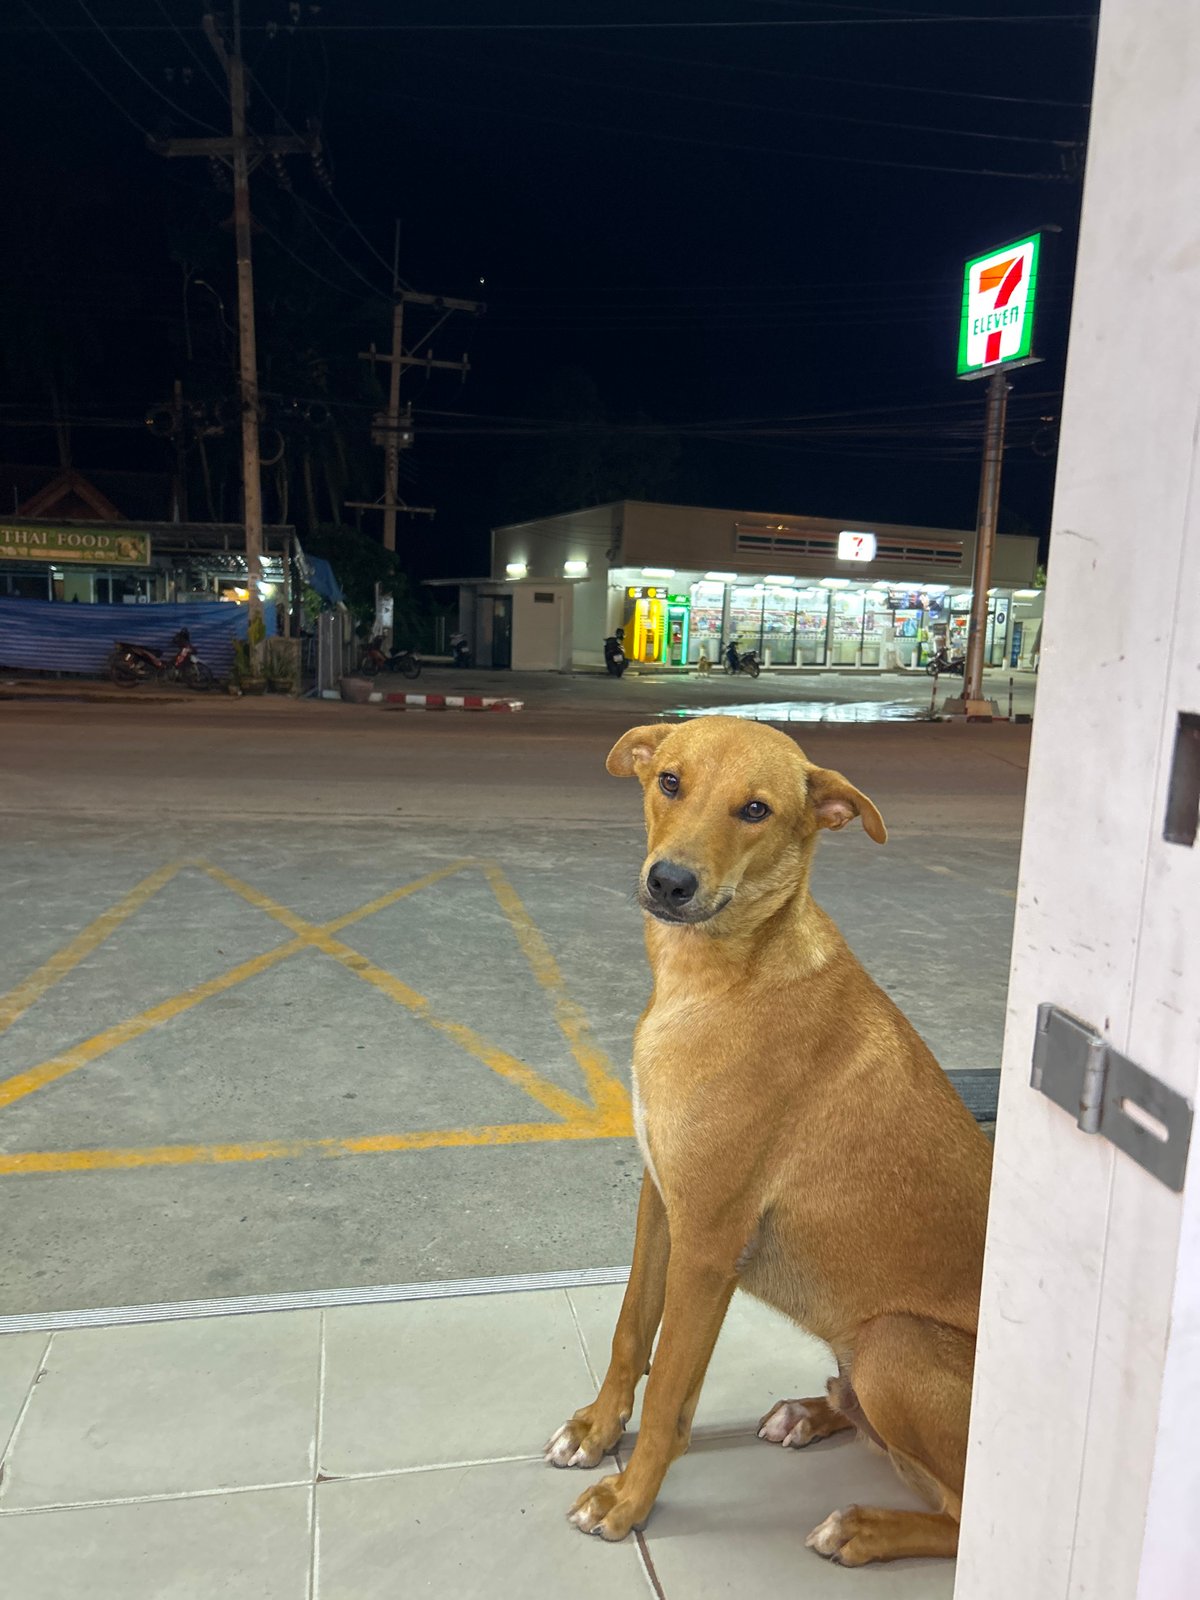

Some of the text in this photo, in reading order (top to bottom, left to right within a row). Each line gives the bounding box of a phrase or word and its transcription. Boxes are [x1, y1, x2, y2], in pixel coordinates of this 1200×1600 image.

[978, 255, 1024, 364] 7
[1, 529, 110, 547] THAI FOOD
[852, 536, 863, 557] 7
